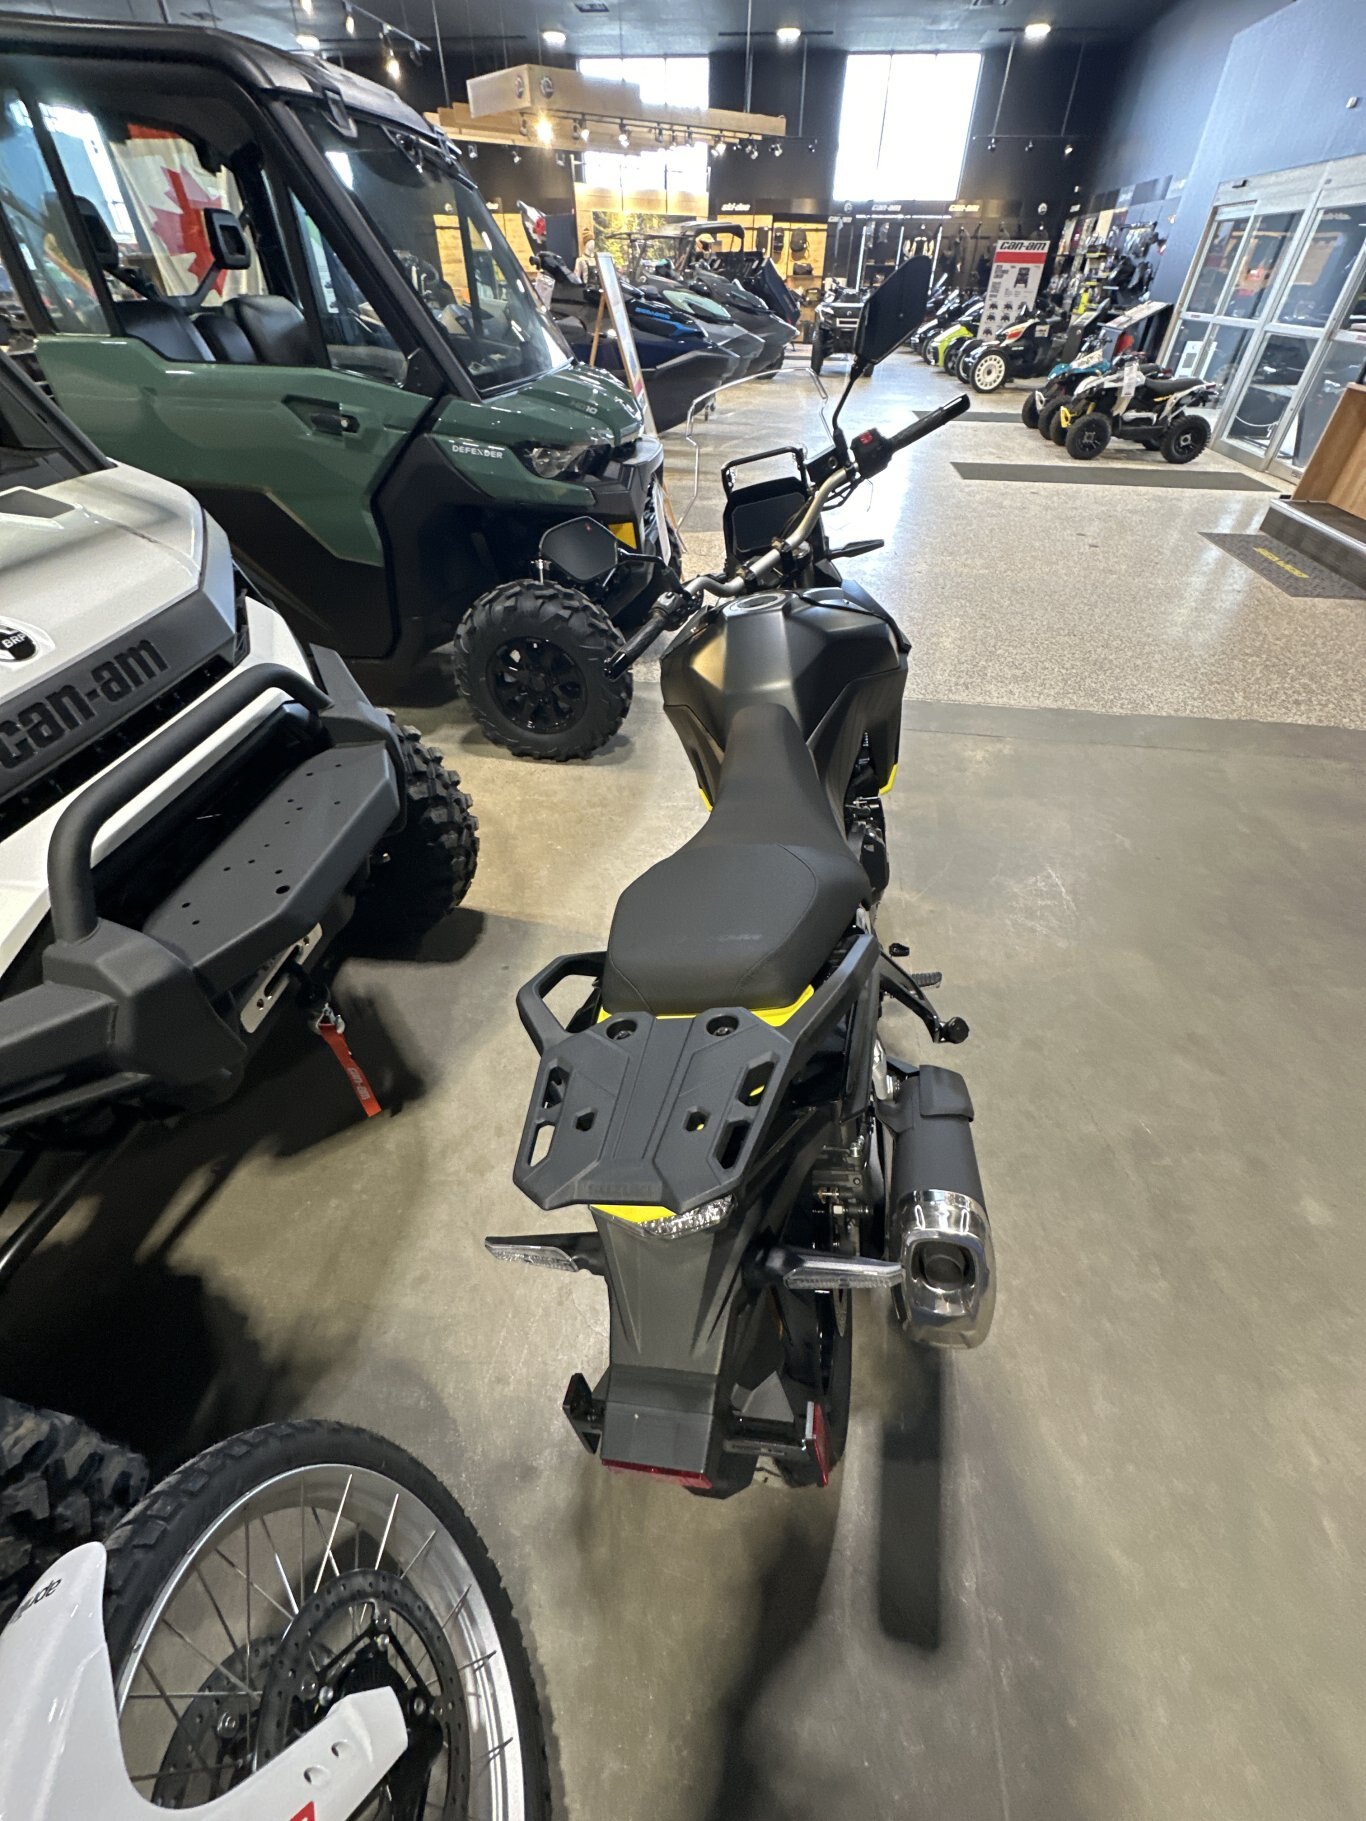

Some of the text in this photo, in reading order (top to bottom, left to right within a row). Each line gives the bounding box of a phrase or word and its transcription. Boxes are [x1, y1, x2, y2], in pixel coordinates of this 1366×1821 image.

[1000, 241, 1047, 251] can-am
[452, 444, 503, 459] DEFENDER
[2, 632, 27, 649] BRP
[0, 639, 169, 769] can-am
